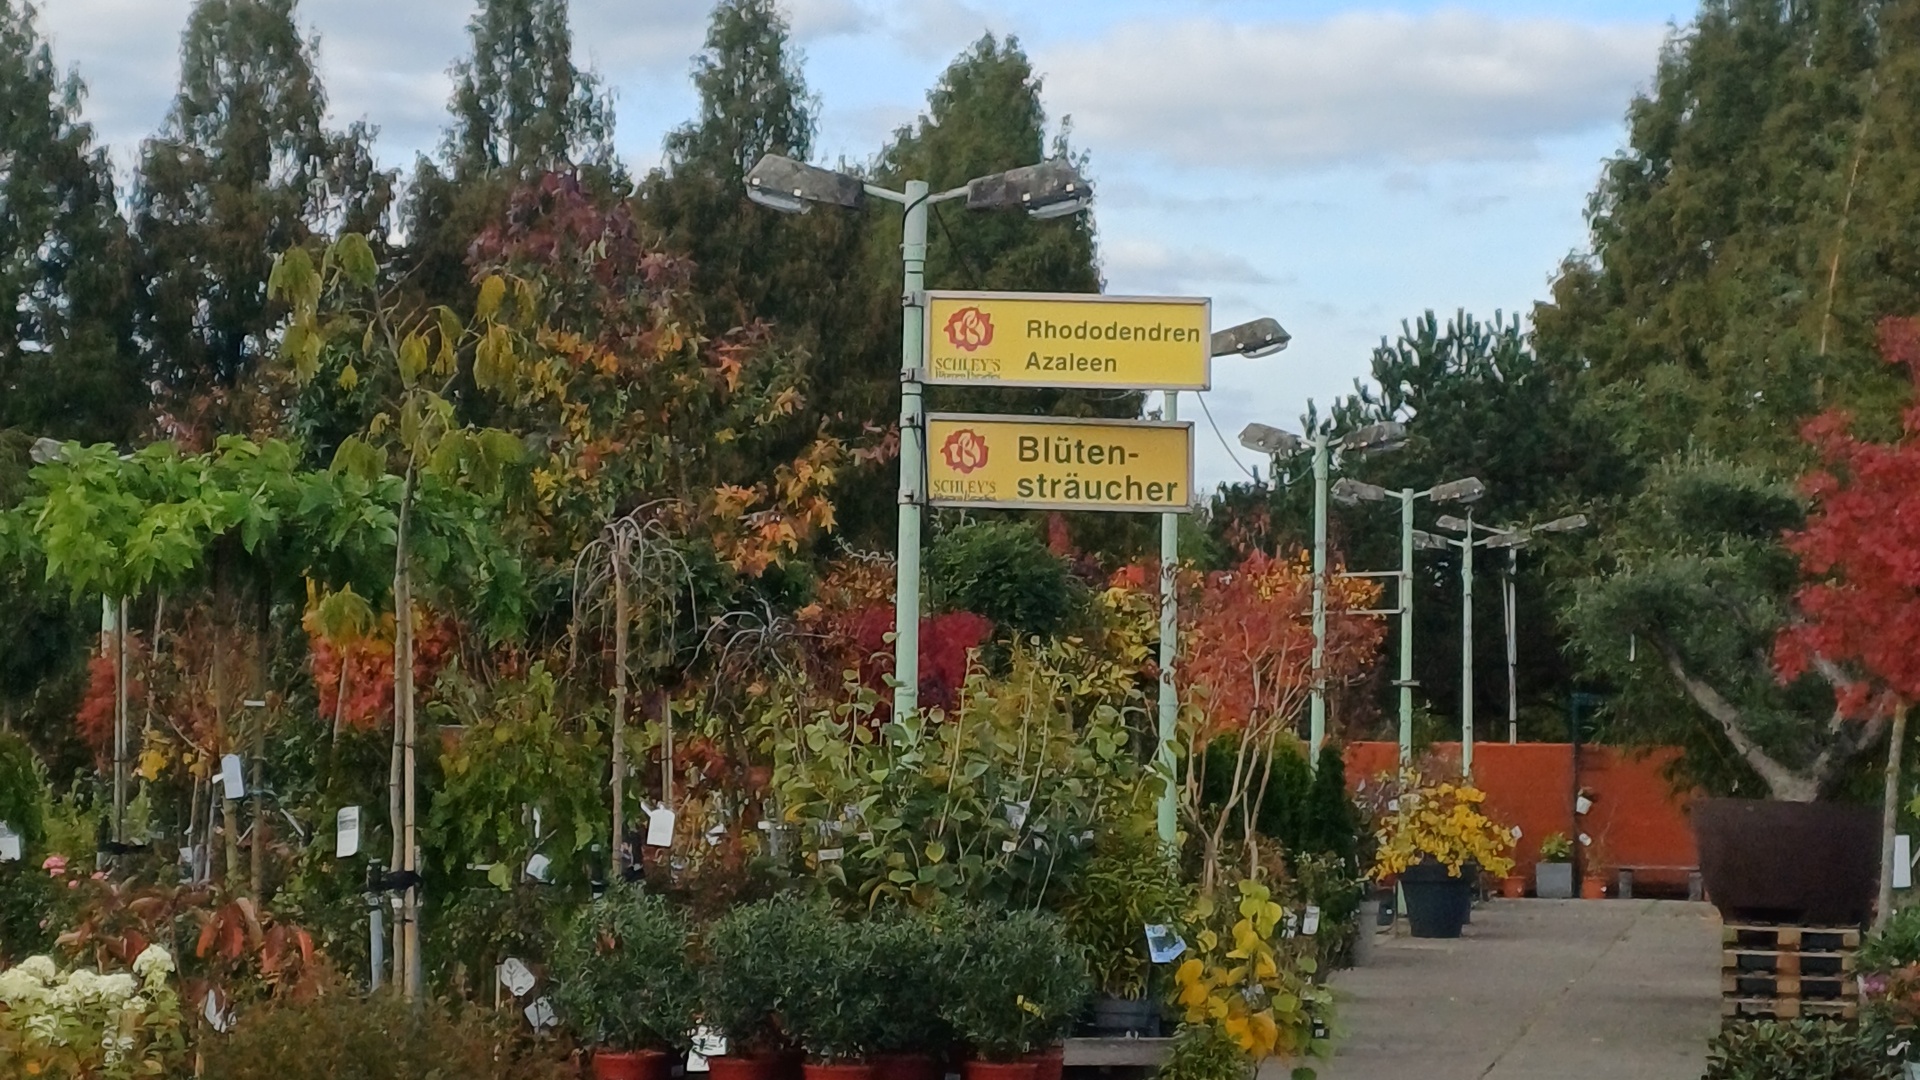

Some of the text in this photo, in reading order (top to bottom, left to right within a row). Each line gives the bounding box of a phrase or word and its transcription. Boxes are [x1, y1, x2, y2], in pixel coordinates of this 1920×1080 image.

[1026, 319, 1200, 343] Rhododendren
[1025, 352, 1117, 372] Azaleen
[1018, 435, 1139, 465] Blüten-
[1017, 472, 1178, 502] sträucher
